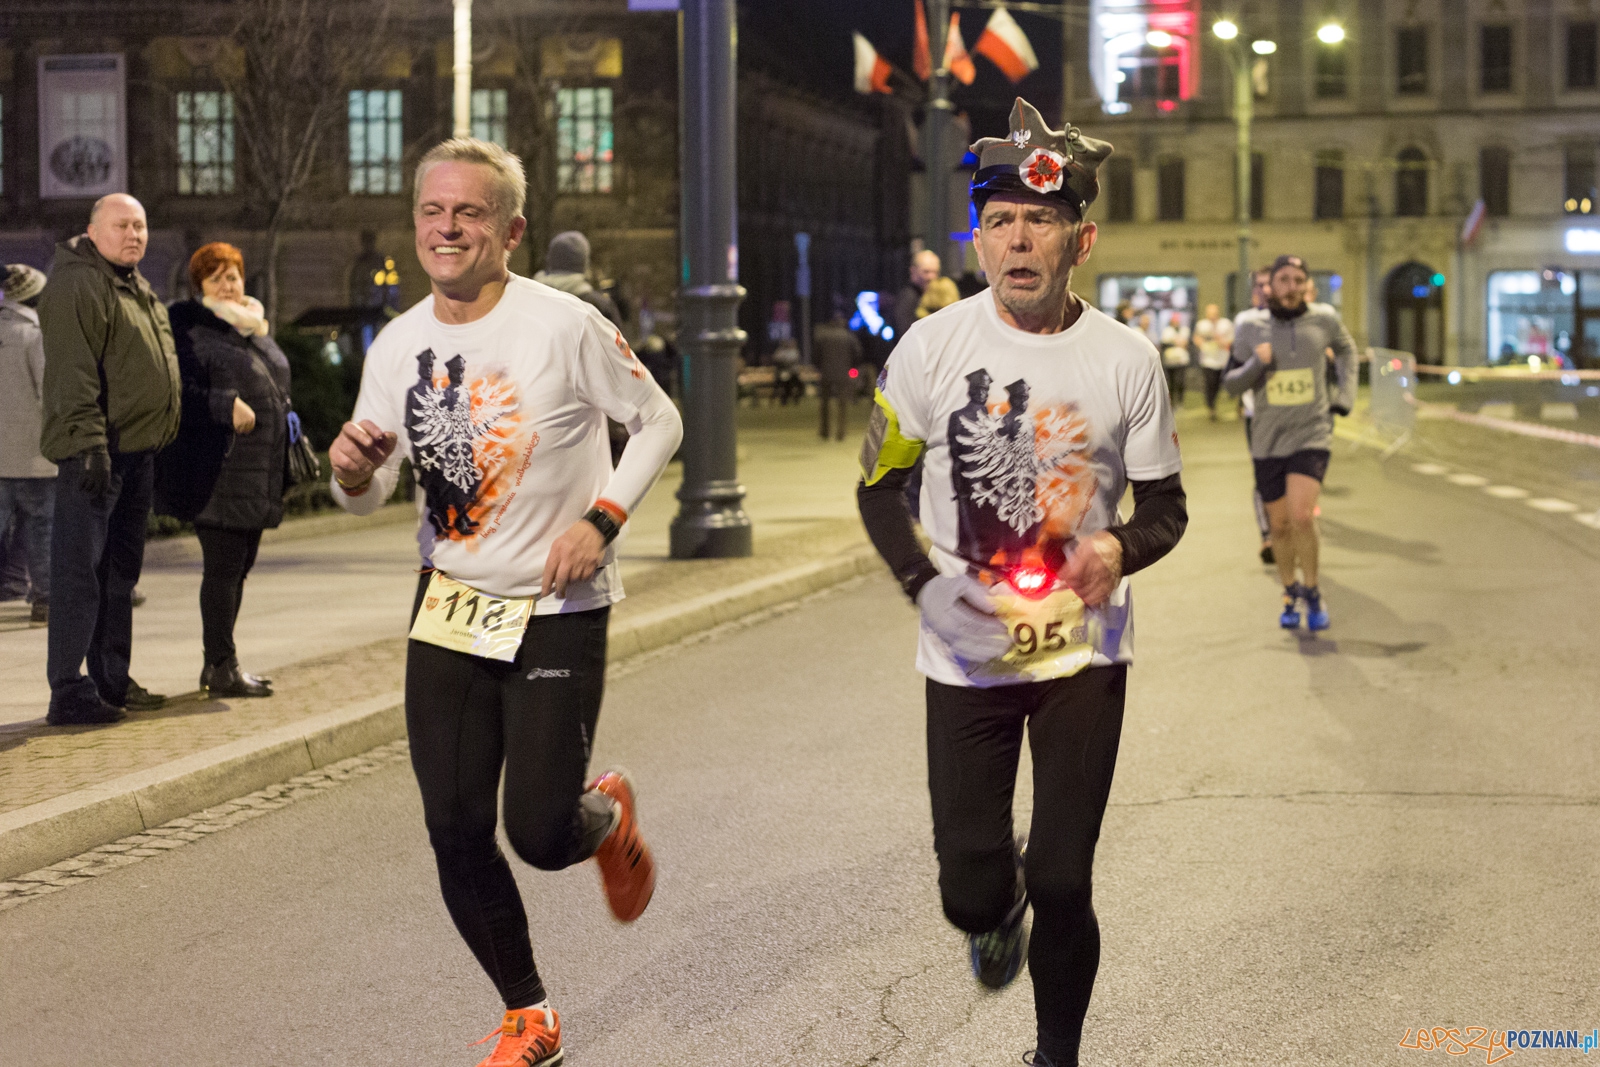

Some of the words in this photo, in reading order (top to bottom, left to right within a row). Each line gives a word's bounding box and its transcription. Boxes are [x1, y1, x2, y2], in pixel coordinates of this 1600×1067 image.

[1277, 380, 1306, 395] 143
[494, 492, 516, 526] powstania
[445, 591, 507, 632] 118
[1013, 621, 1067, 655] 95
